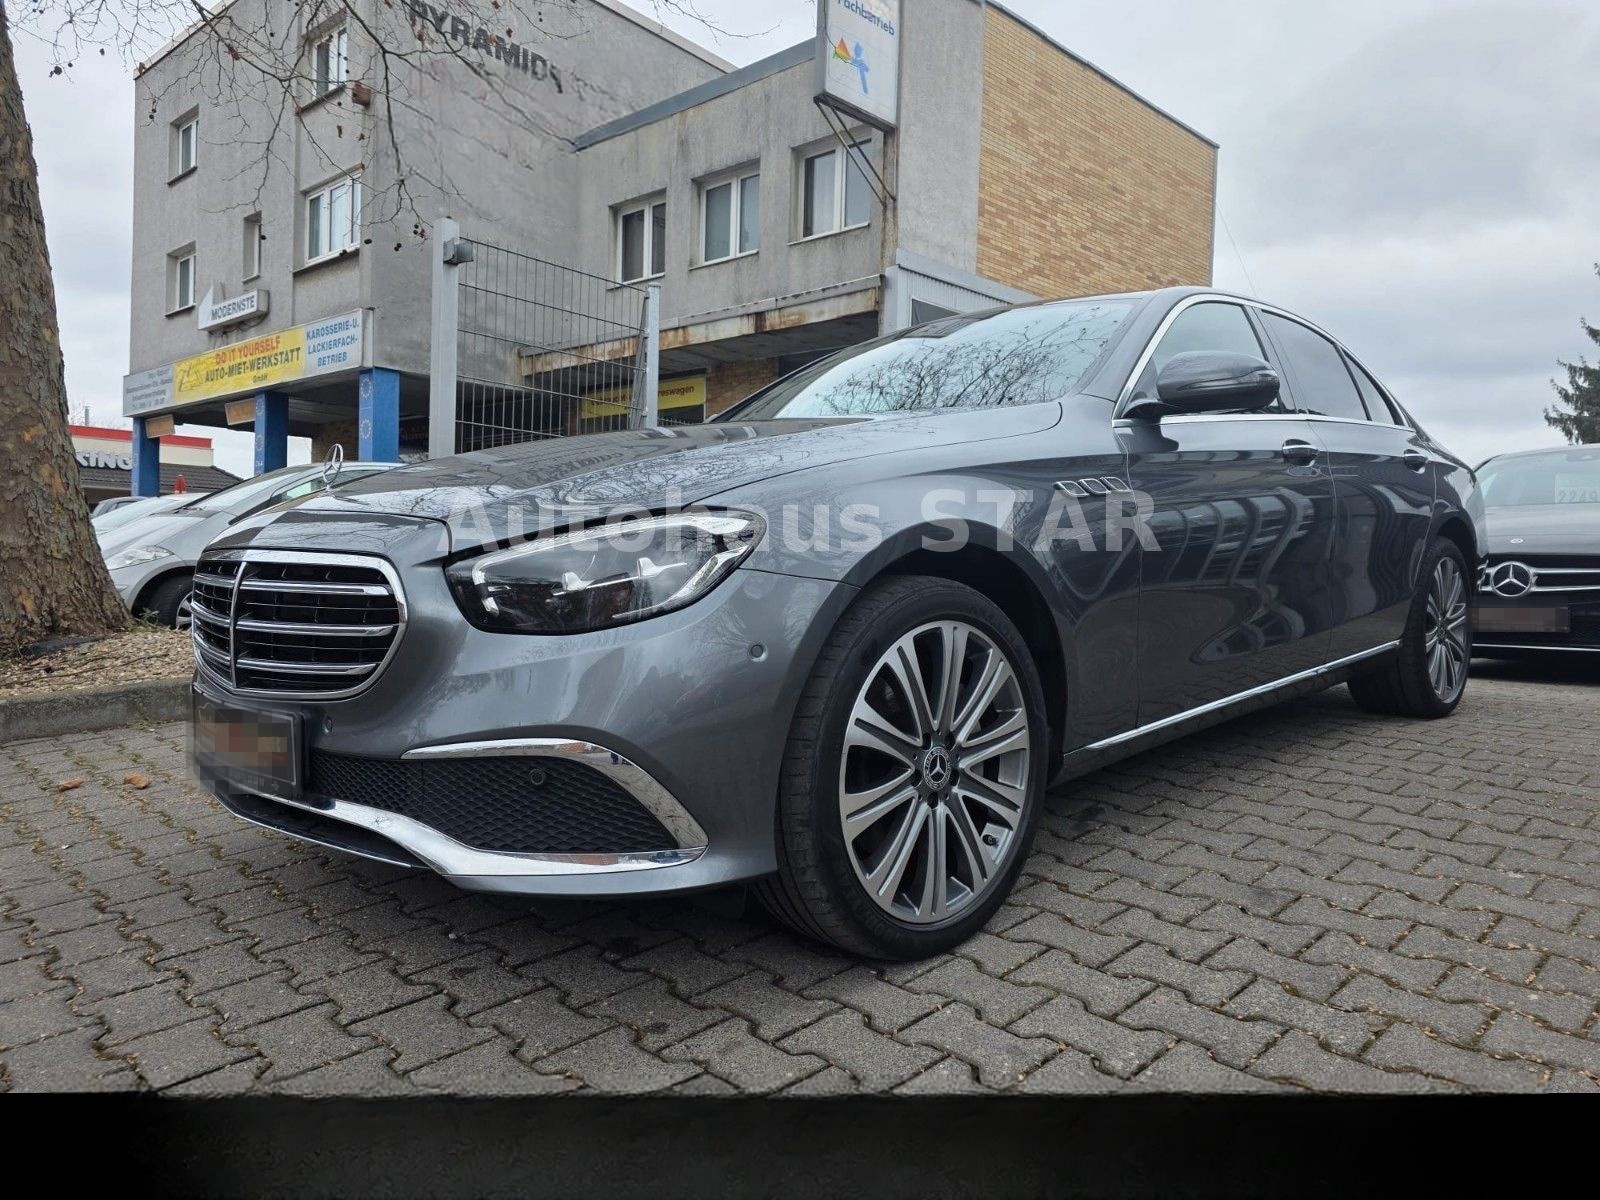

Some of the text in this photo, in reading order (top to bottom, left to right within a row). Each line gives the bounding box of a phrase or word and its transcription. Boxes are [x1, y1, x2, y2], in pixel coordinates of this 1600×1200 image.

[211, 295, 255, 320] MODERNSTE
[215, 336, 281, 365] DO IT YOURSELF
[308, 333, 358, 355] LACKIERFACH-
[205, 346, 301, 383] AUTO-MIET-WERKSTATT
[317, 351, 347, 367] BETRIEB
